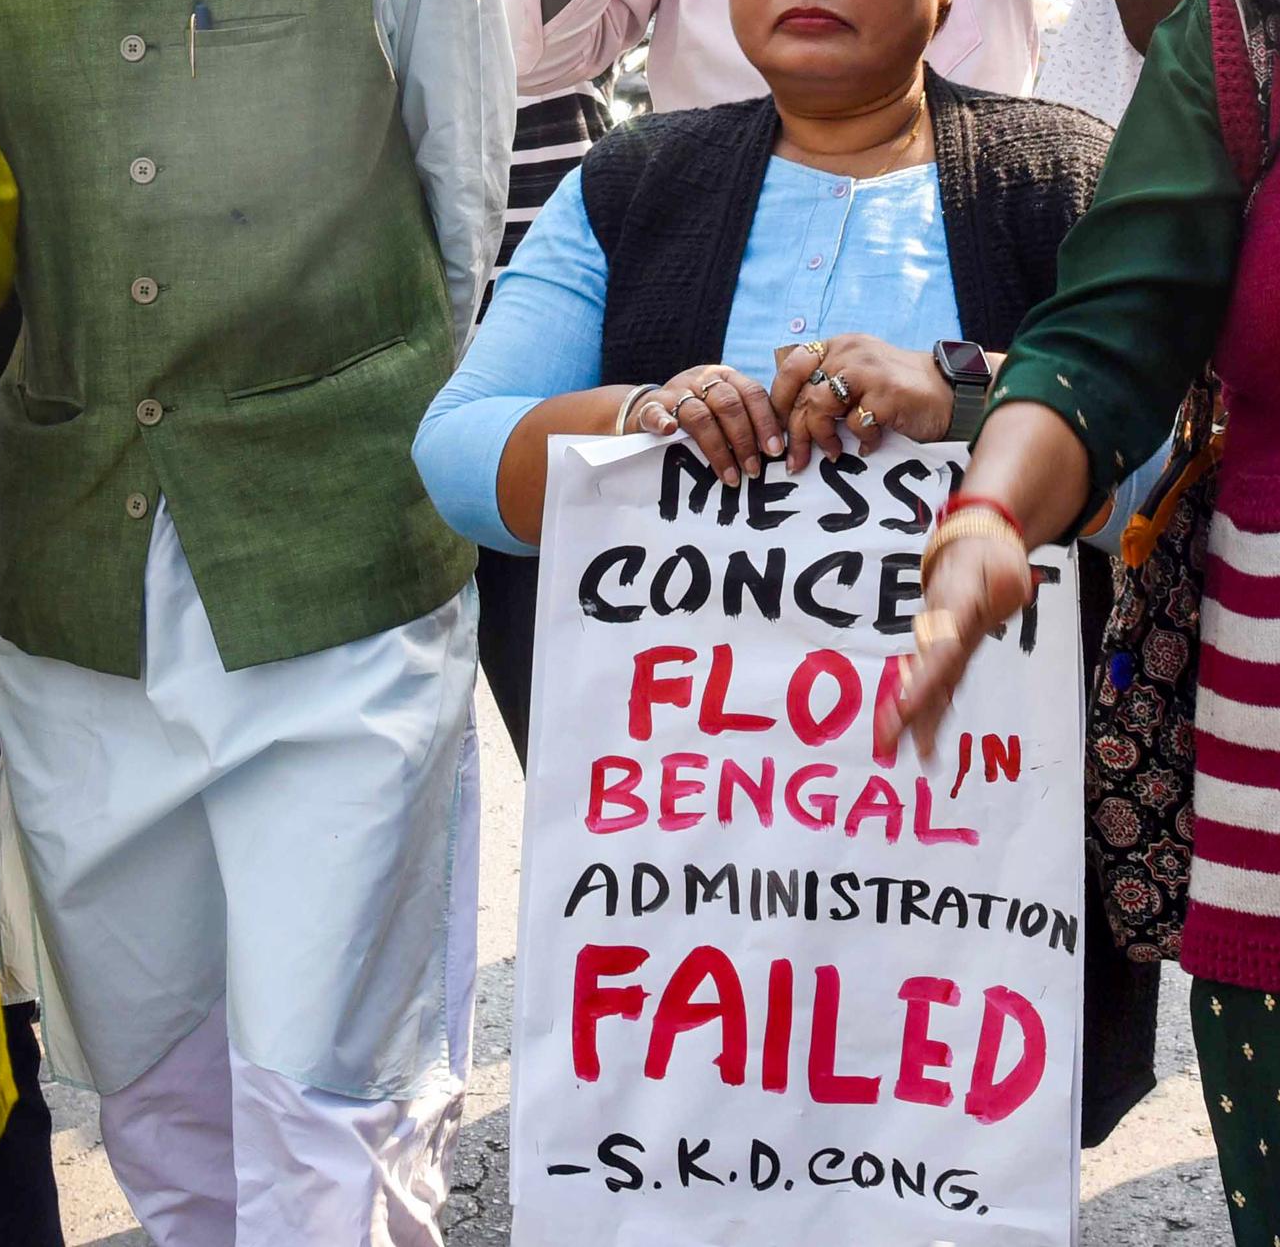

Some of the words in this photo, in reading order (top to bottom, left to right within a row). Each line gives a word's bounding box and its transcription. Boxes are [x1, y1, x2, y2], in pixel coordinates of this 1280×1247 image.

[578, 543, 1062, 656] CONCET
[584, 755, 981, 846] BENGAL
[949, 731, 1022, 799] IN
[563, 862, 1078, 955] ADMINISTRATION
[572, 943, 1047, 1126] FAILED
